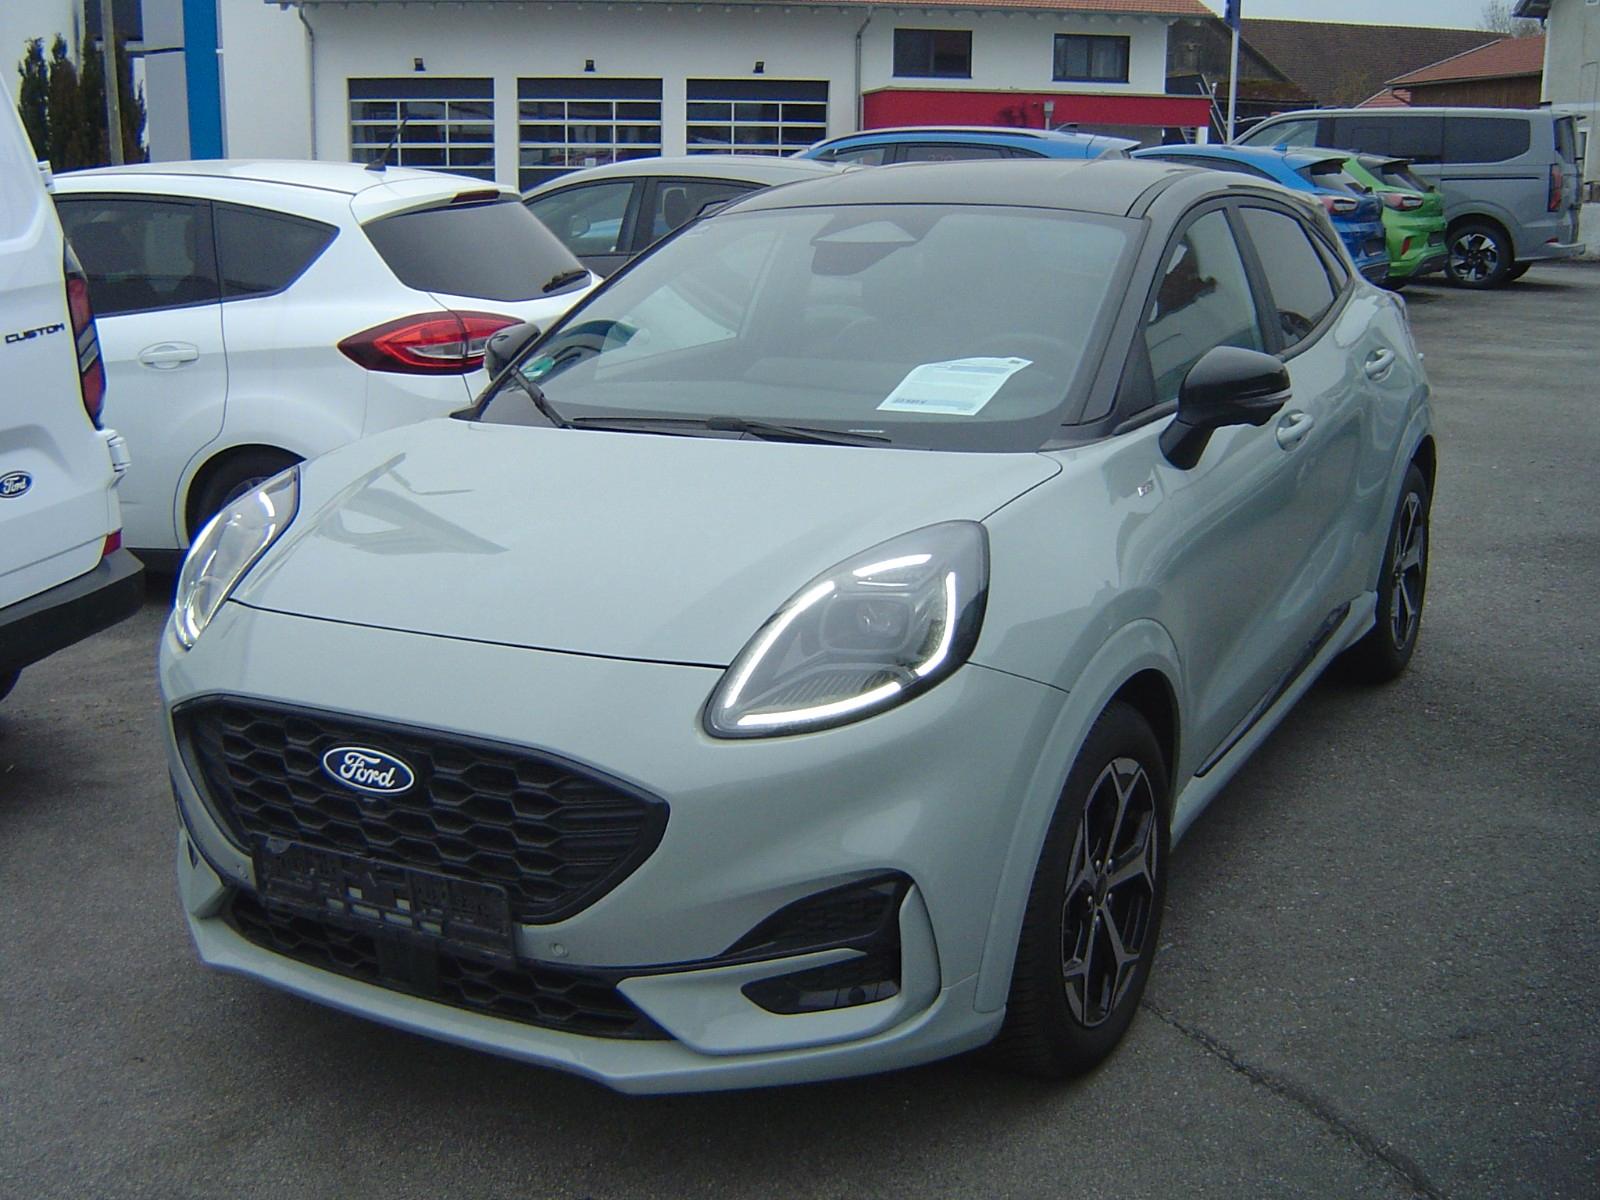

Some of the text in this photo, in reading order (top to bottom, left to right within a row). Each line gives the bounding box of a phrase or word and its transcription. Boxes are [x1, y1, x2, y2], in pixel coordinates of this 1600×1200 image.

[5, 323, 65, 344] CUSTOM
[2, 476, 28, 495] Ford
[340, 752, 396, 788] Ford
